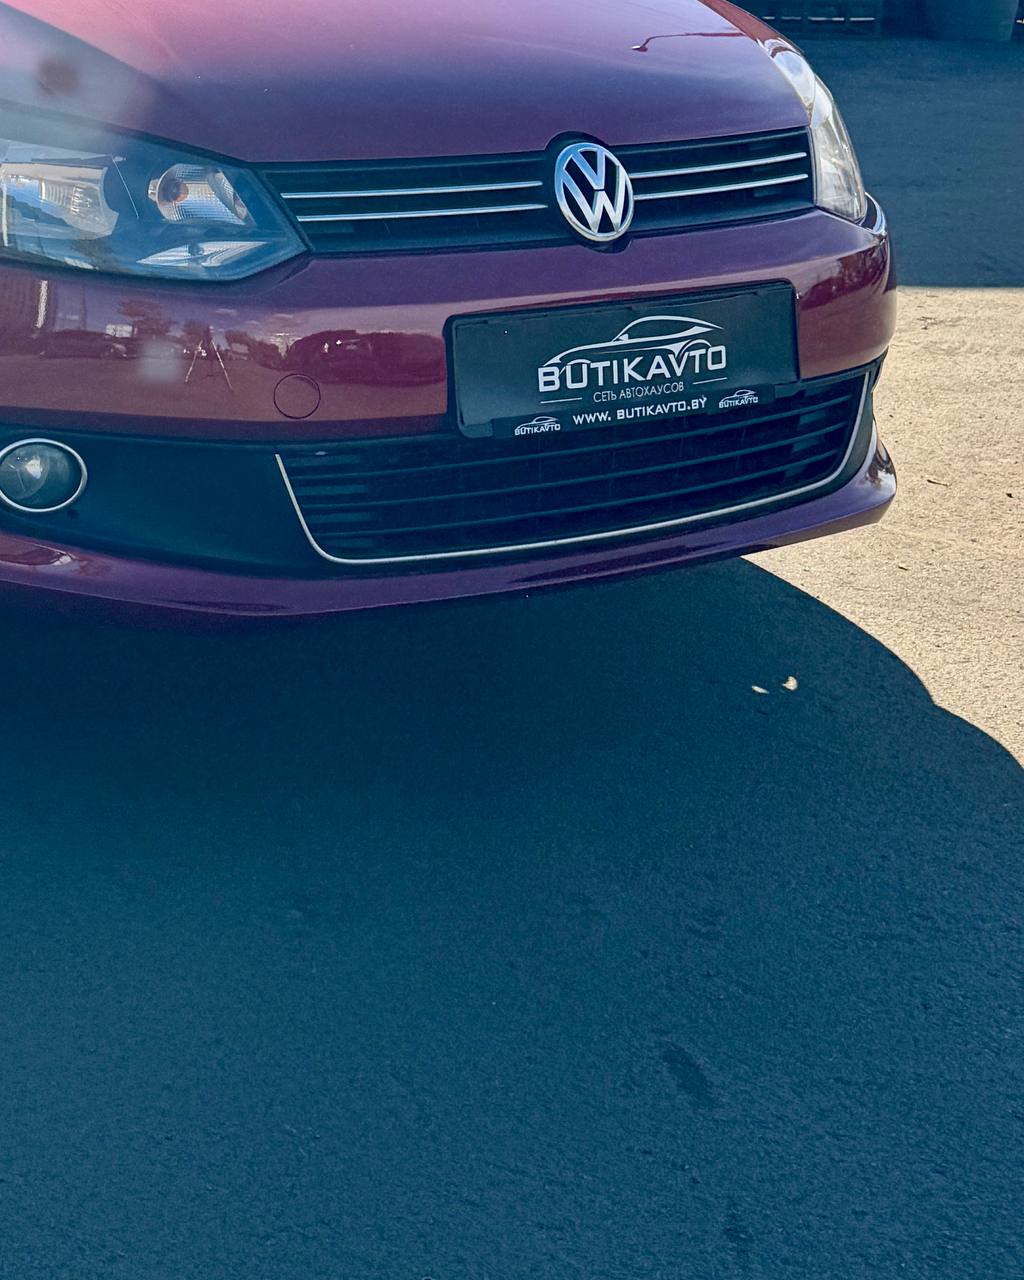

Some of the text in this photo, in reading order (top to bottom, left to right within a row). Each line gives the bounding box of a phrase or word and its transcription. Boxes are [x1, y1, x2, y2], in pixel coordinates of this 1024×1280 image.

[538, 345, 727, 393] BUTIKAVTO
[593, 381, 685, 403] СЕТЬ АВТОХАУСОВ
[718, 396, 759, 409] BUTIKAVTO
[572, 396, 708, 425] WWW. BUTIKAVTO.BY
[514, 423, 561, 436] BUTIKAVTO
